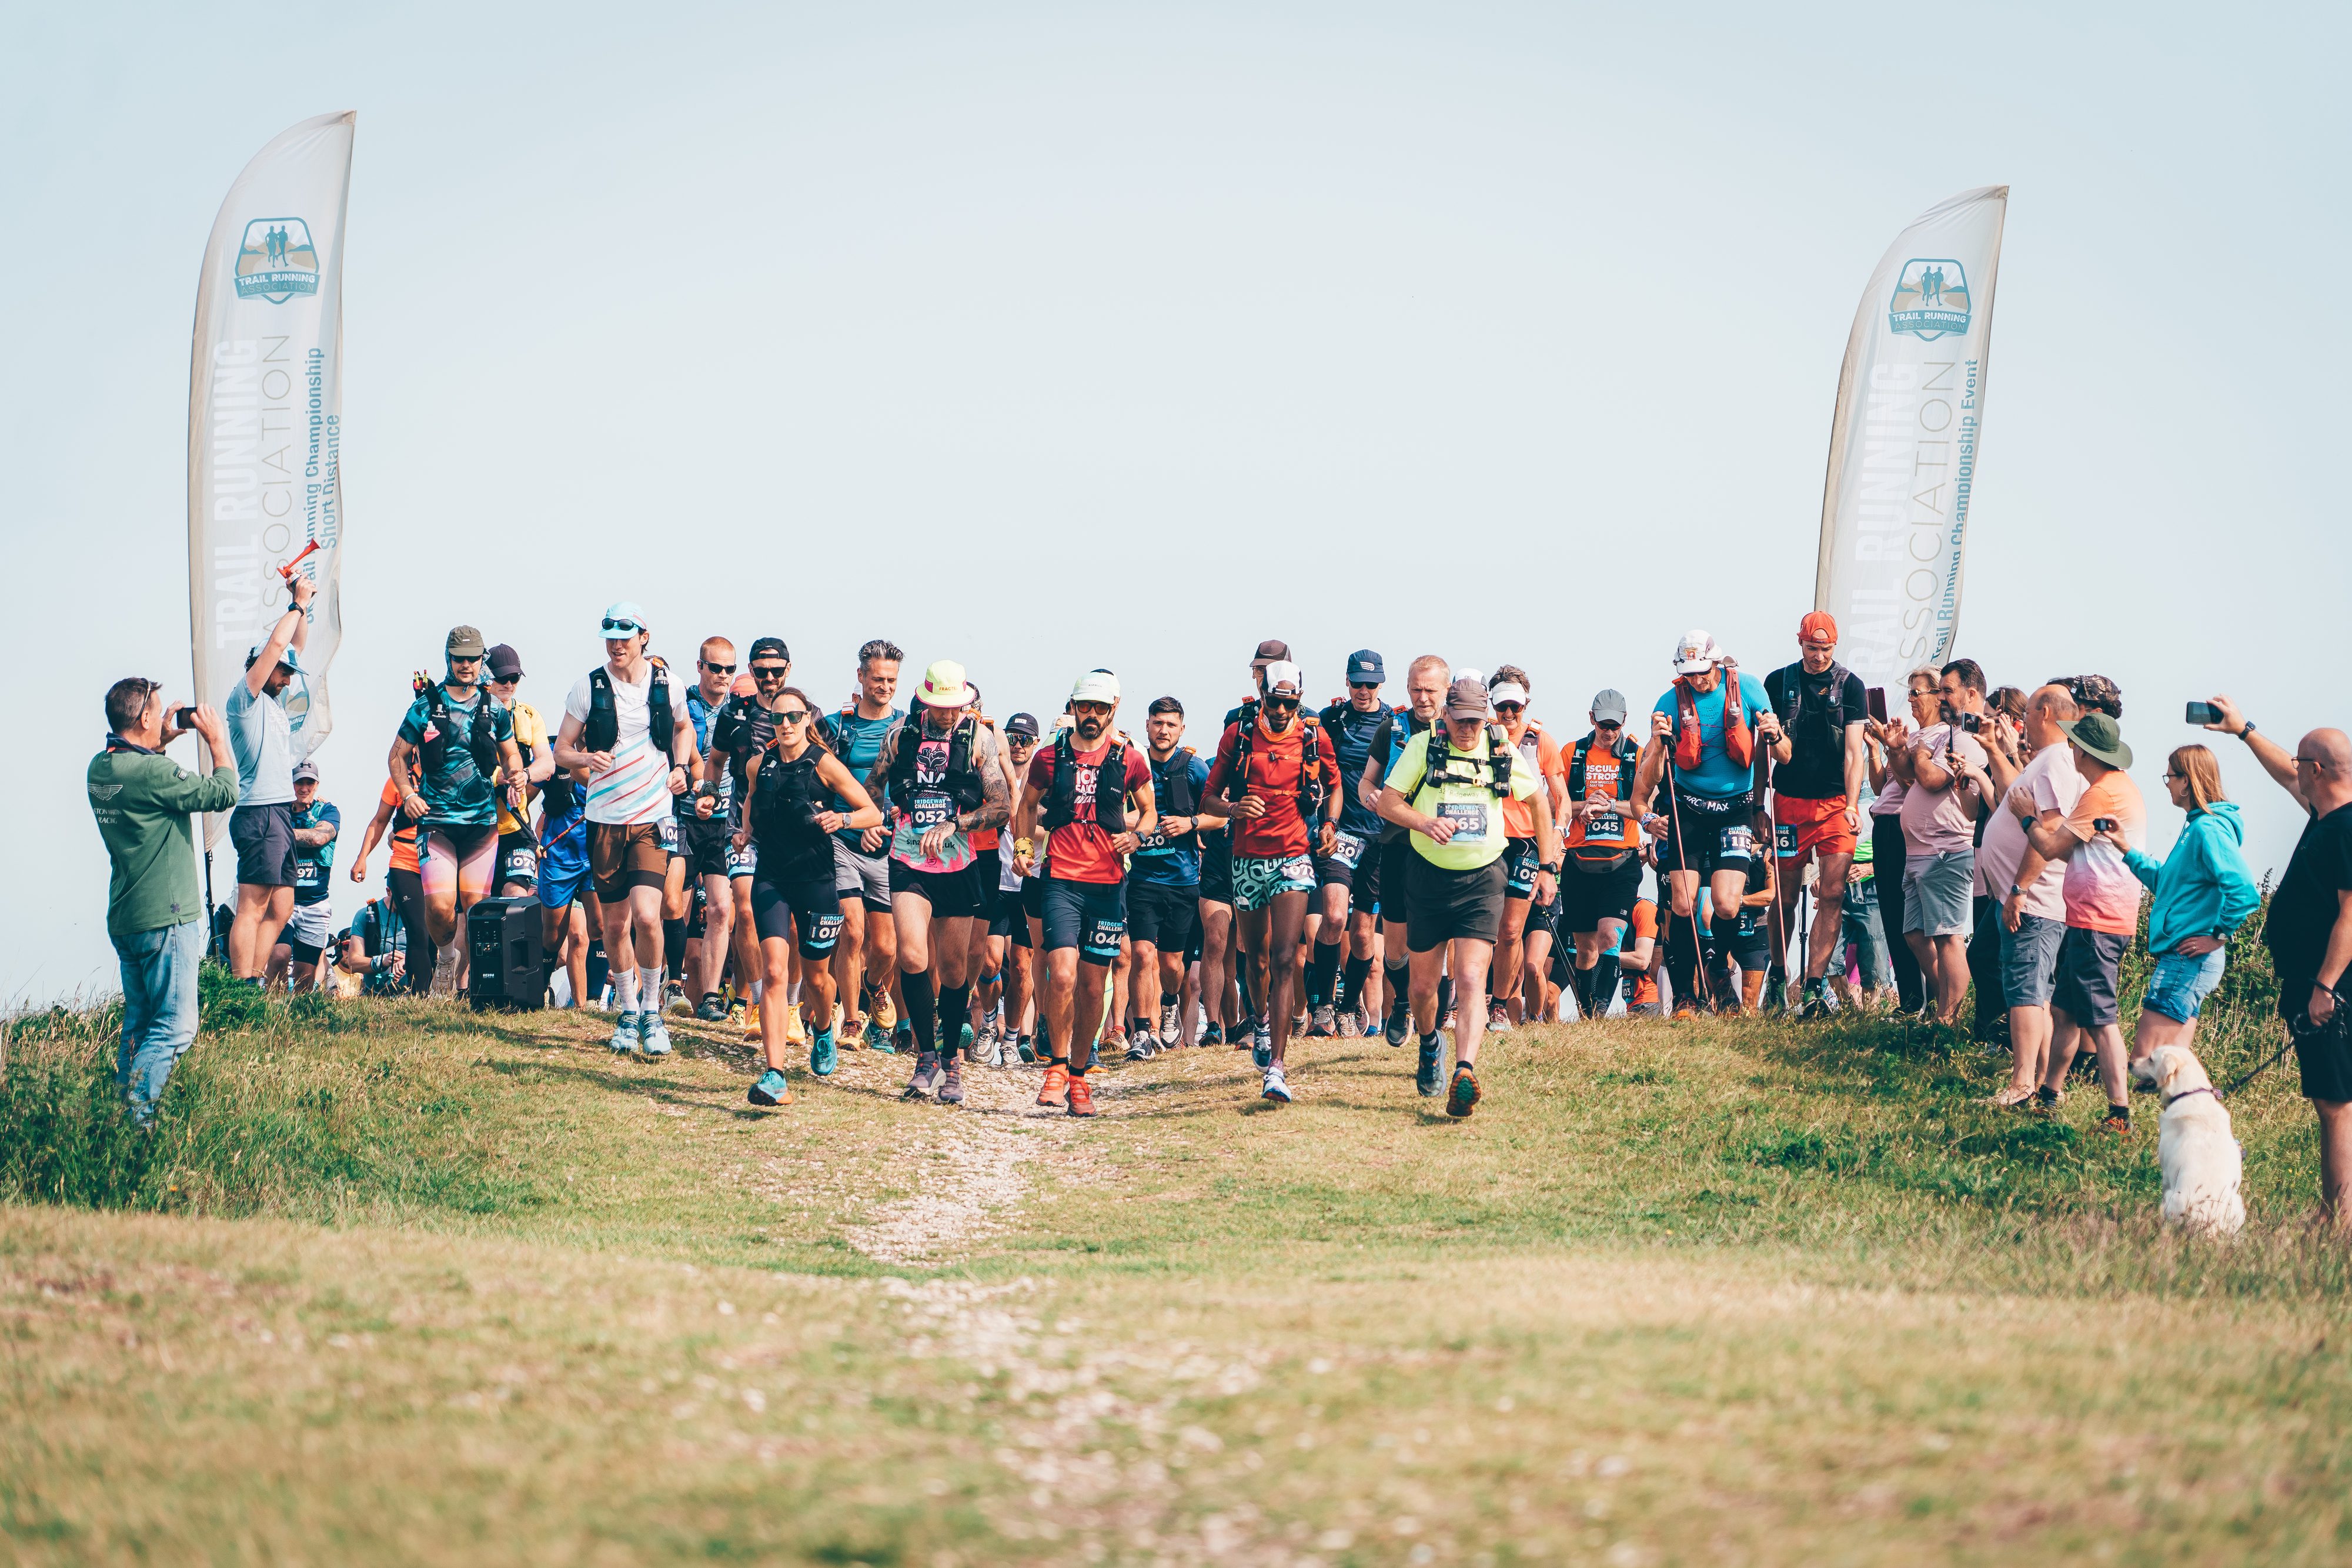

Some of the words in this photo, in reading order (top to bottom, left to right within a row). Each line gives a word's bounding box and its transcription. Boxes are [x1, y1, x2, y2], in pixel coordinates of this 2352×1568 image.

[239, 275, 268, 286] TRAIL
[272, 273, 316, 283] RUNNING
[240, 283, 315, 295] ASSOCIATION
[1893, 312, 1921, 322] TRAIL
[1925, 312, 1966, 323] RUNNING
[1895, 321, 1965, 331] ASSOCIATION
[1961, 359, 1978, 410] Event
[305, 348, 325, 477] Championship
[213, 339, 259, 521] RUNNING
[322, 414, 340, 495] Distance
[1855, 363, 1919, 561] RUNNING
[1950, 415, 1978, 545] Championship
[303, 483, 321, 554] unning
[320, 499, 337, 550] Short
[214, 534, 259, 649] TRAIL
[1937, 550, 1962, 620] Running
[1847, 578, 1902, 688] RAIL
[1930, 627, 1950, 663] Trail
[1586, 772, 1618, 781] STROP
[1449, 790, 1479, 799] Ridgeway
[1707, 801, 1729, 812] MAX
[915, 810, 947, 823] 052
[1449, 817, 1479, 830] 65
[1592, 821, 1619, 831] 045
[667, 828, 677, 842] 04
[1334, 834, 1358, 847] HALLENGE
[1335, 831, 1359, 841] IDGEWAY
[1337, 842, 1355, 857] 60
[1731, 836, 1751, 850] 115
[513, 857, 536, 871] 079
[726, 853, 750, 869] 005
[1522, 861, 1539, 870] CHALL
[297, 868, 314, 878] 97
[1289, 864, 1315, 878] 072
[1519, 868, 1538, 882] 09
[1095, 932, 1122, 945] 044
